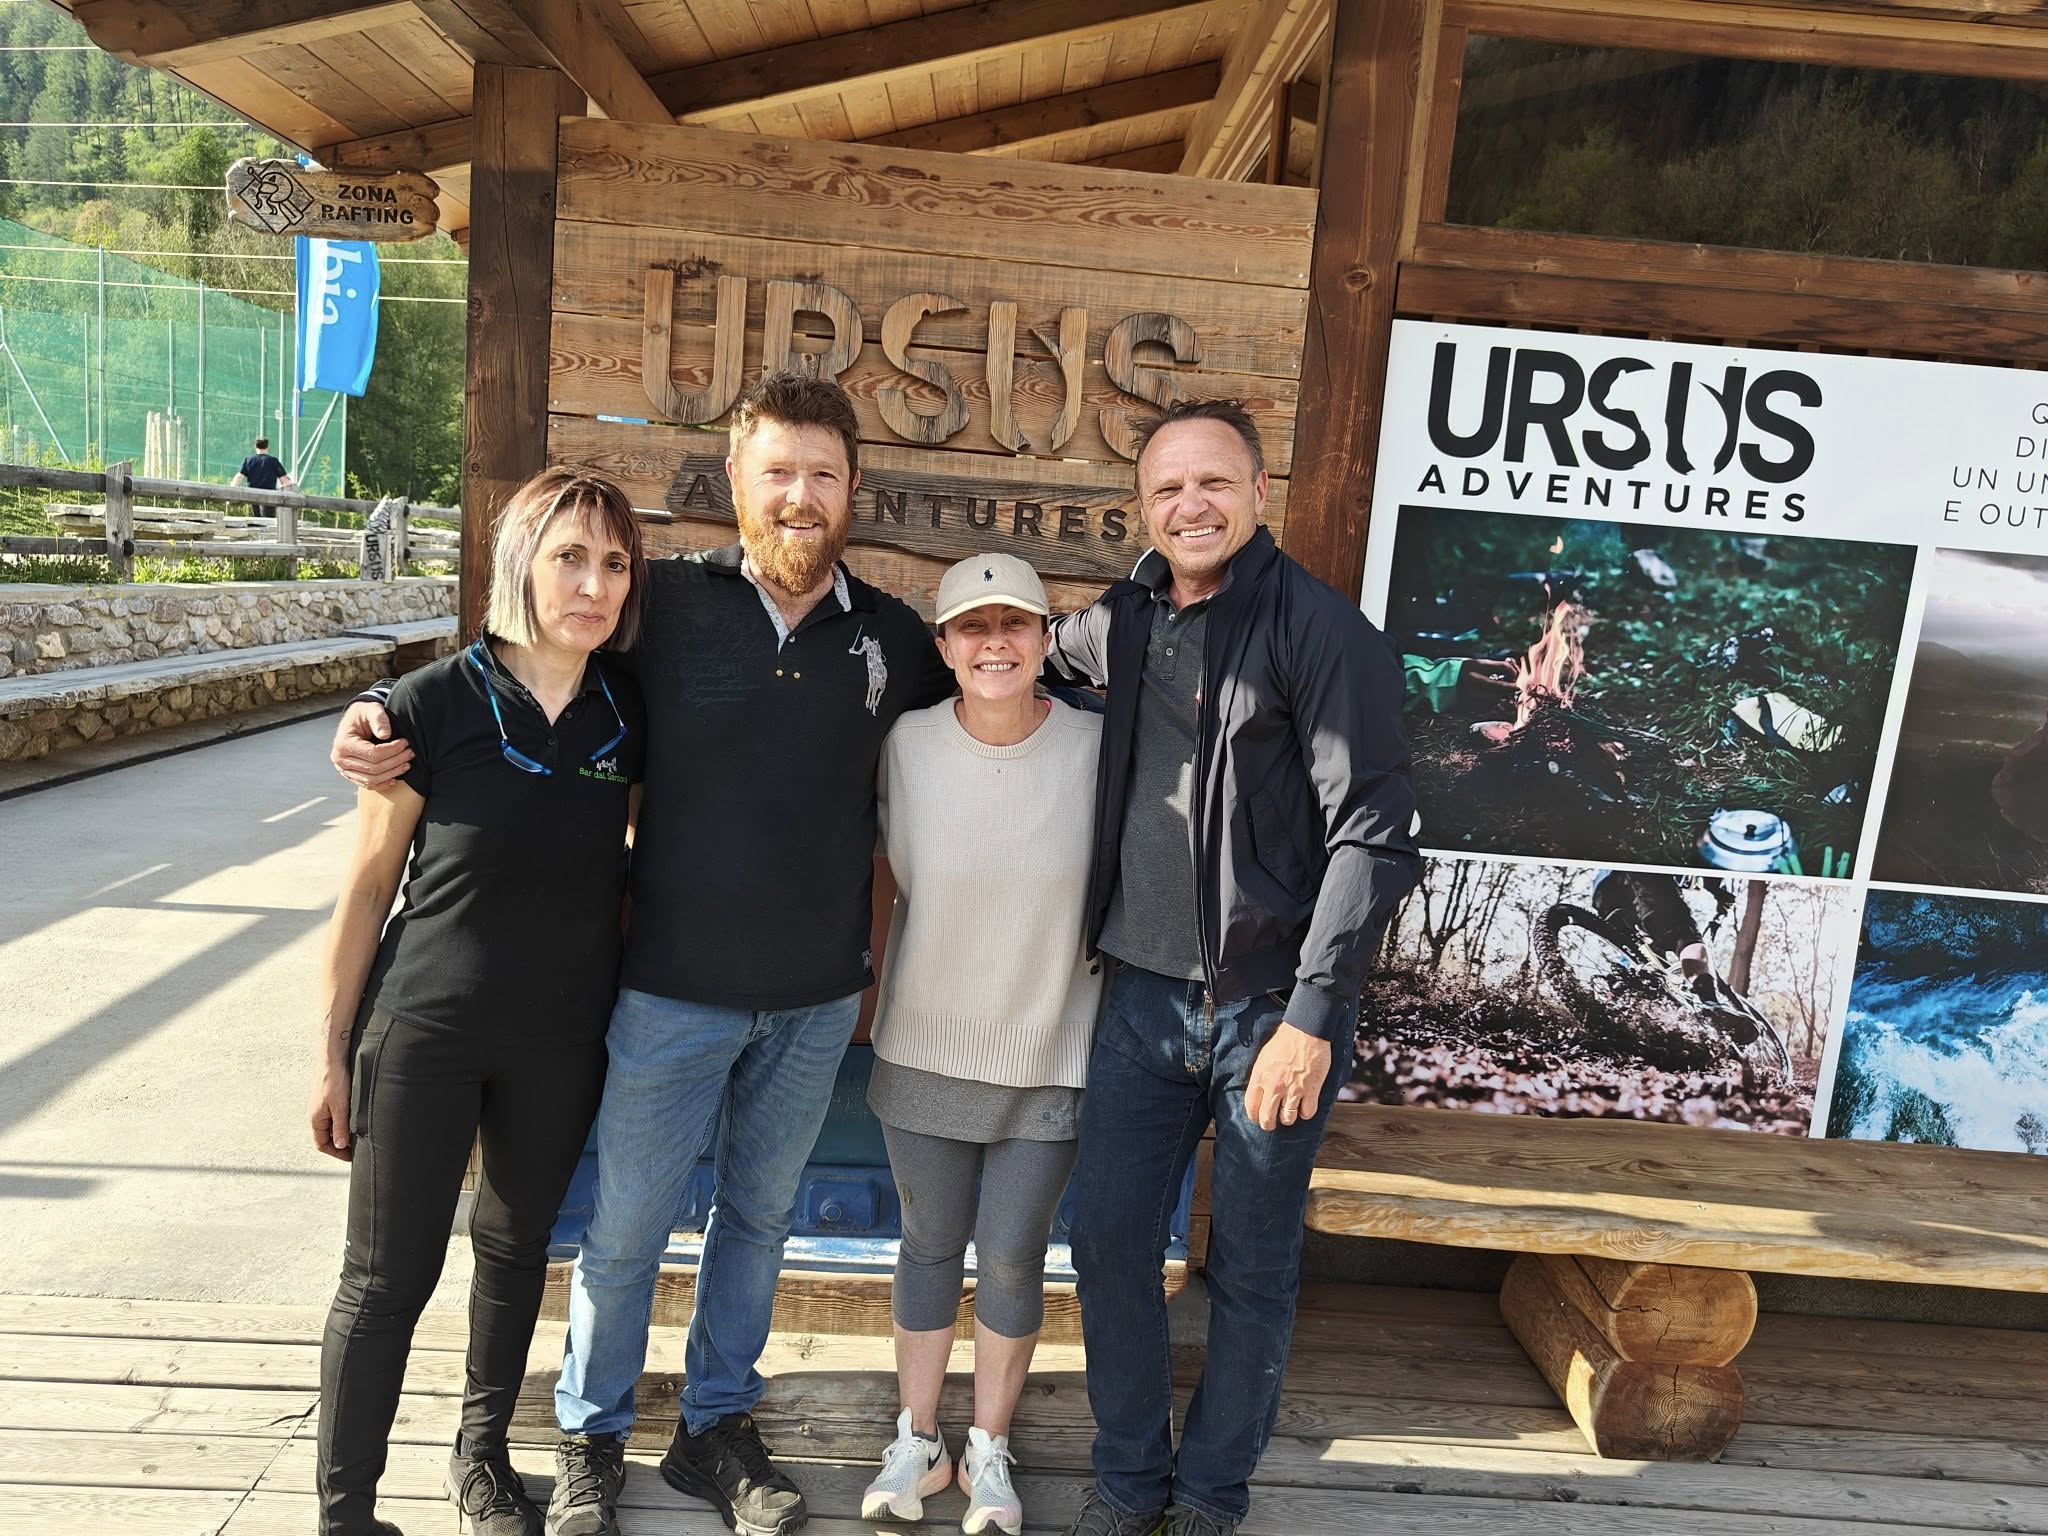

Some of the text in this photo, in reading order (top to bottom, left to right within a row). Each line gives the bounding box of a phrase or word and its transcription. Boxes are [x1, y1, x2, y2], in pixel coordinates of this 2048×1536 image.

[338, 184, 397, 203] ZONA
[321, 204, 414, 224] RAFTING
[642, 269, 1200, 463] URSUS
[1427, 341, 1822, 484] URSUS
[2016, 436, 2048, 459] DI
[1953, 466, 1997, 490] UN
[1417, 463, 1806, 523] ADVENTURES
[683, 474, 1127, 541] ANTURES
[1944, 500, 2048, 529] E OUT
[579, 767, 592, 777] Bar
